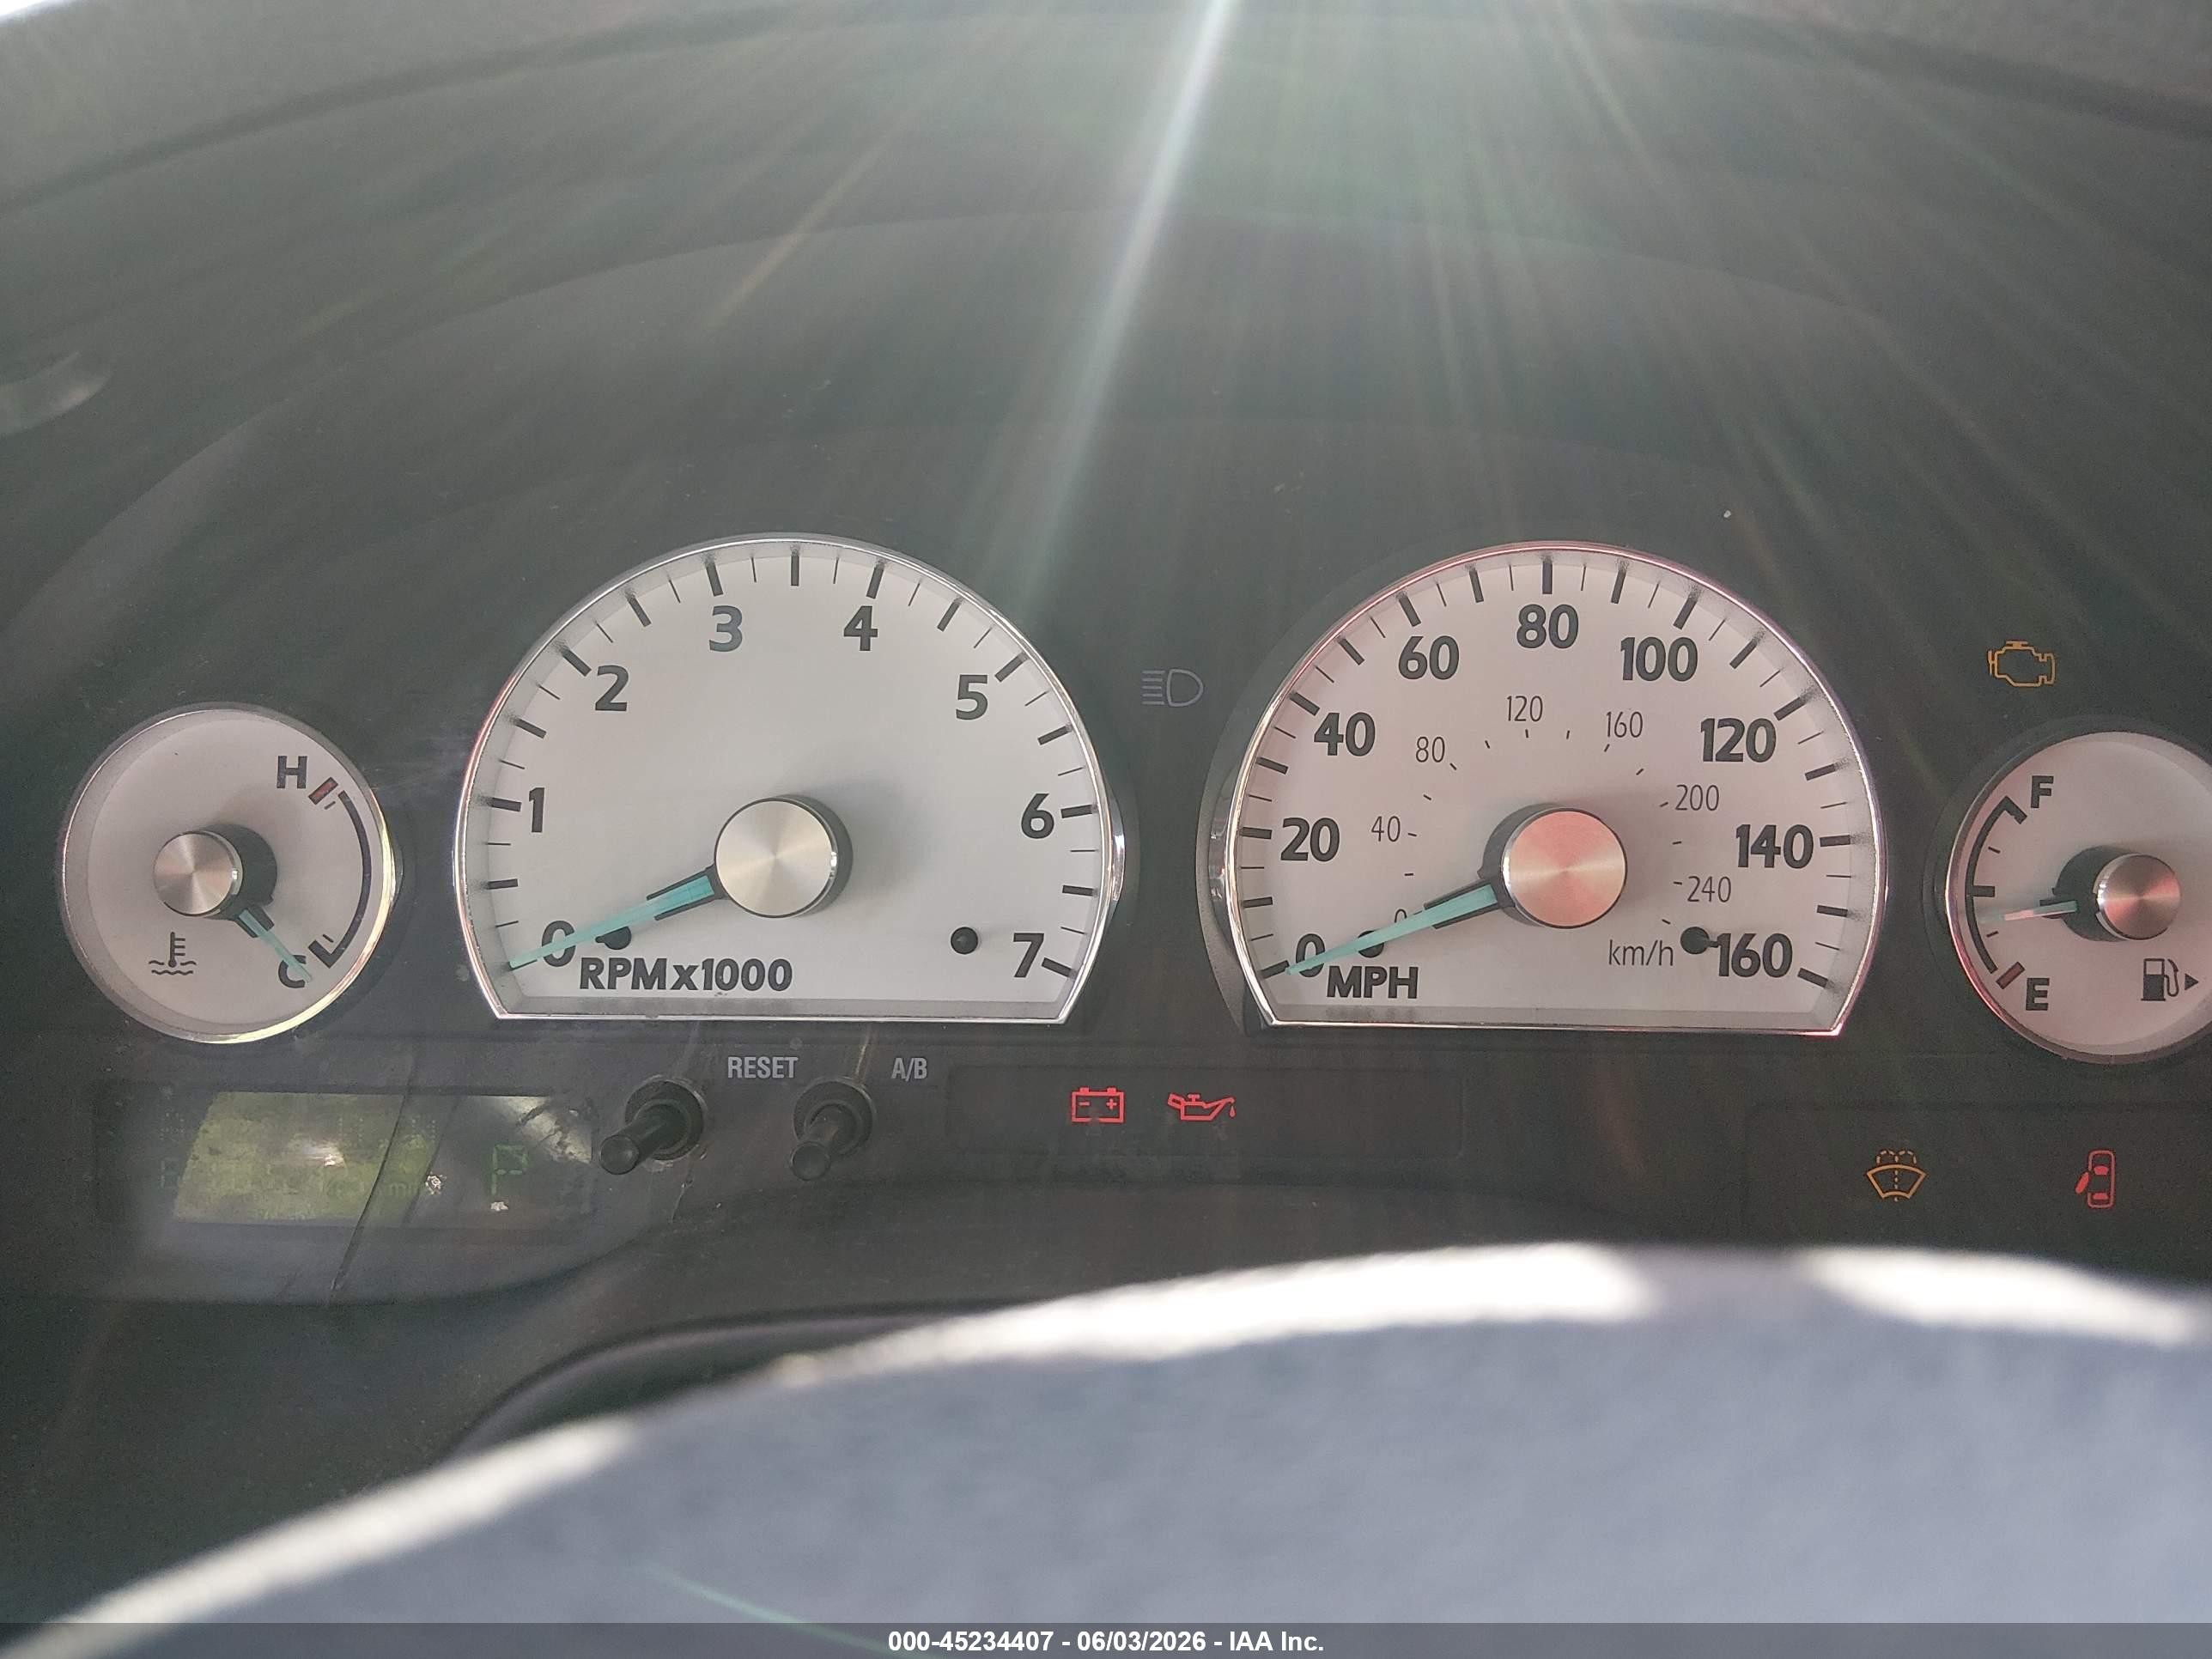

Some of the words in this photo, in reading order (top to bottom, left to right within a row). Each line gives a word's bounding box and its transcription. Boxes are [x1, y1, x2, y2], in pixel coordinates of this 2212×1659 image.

[708, 605, 743, 653] 3
[842, 606, 878, 652] 4
[1516, 604, 1579, 649] 80
[1398, 635, 1459, 680] 60
[1620, 637, 1698, 682] 100
[594, 665, 628, 713] 2
[955, 674, 988, 720] 5
[1506, 695, 1543, 722] 120
[1314, 712, 1375, 757] 40
[1606, 711, 1643, 738] 160
[1701, 718, 1777, 763] 120
[276, 756, 307, 788] H
[1415, 737, 1445, 763] 80
[529, 787, 544, 833] 1
[1675, 784, 1719, 811] 200
[2031, 775, 2054, 808] F
[1021, 793, 1055, 839] 6
[1370, 815, 1401, 842] 40
[1281, 818, 1340, 862] 20
[1735, 824, 1814, 869] 140
[1686, 876, 1731, 903] 240
[541, 921, 576, 968] 0
[1012, 933, 1044, 978] 7
[1296, 933, 1325, 977] 0
[1607, 940, 1674, 969] km/h
[1718, 933, 1792, 978] 160
[278, 954, 307, 988] C
[1327, 965, 1419, 999] MPH
[2026, 977, 2050, 1011] E
[727, 1057, 798, 1079] RESET
[891, 1058, 927, 1079] A/B
